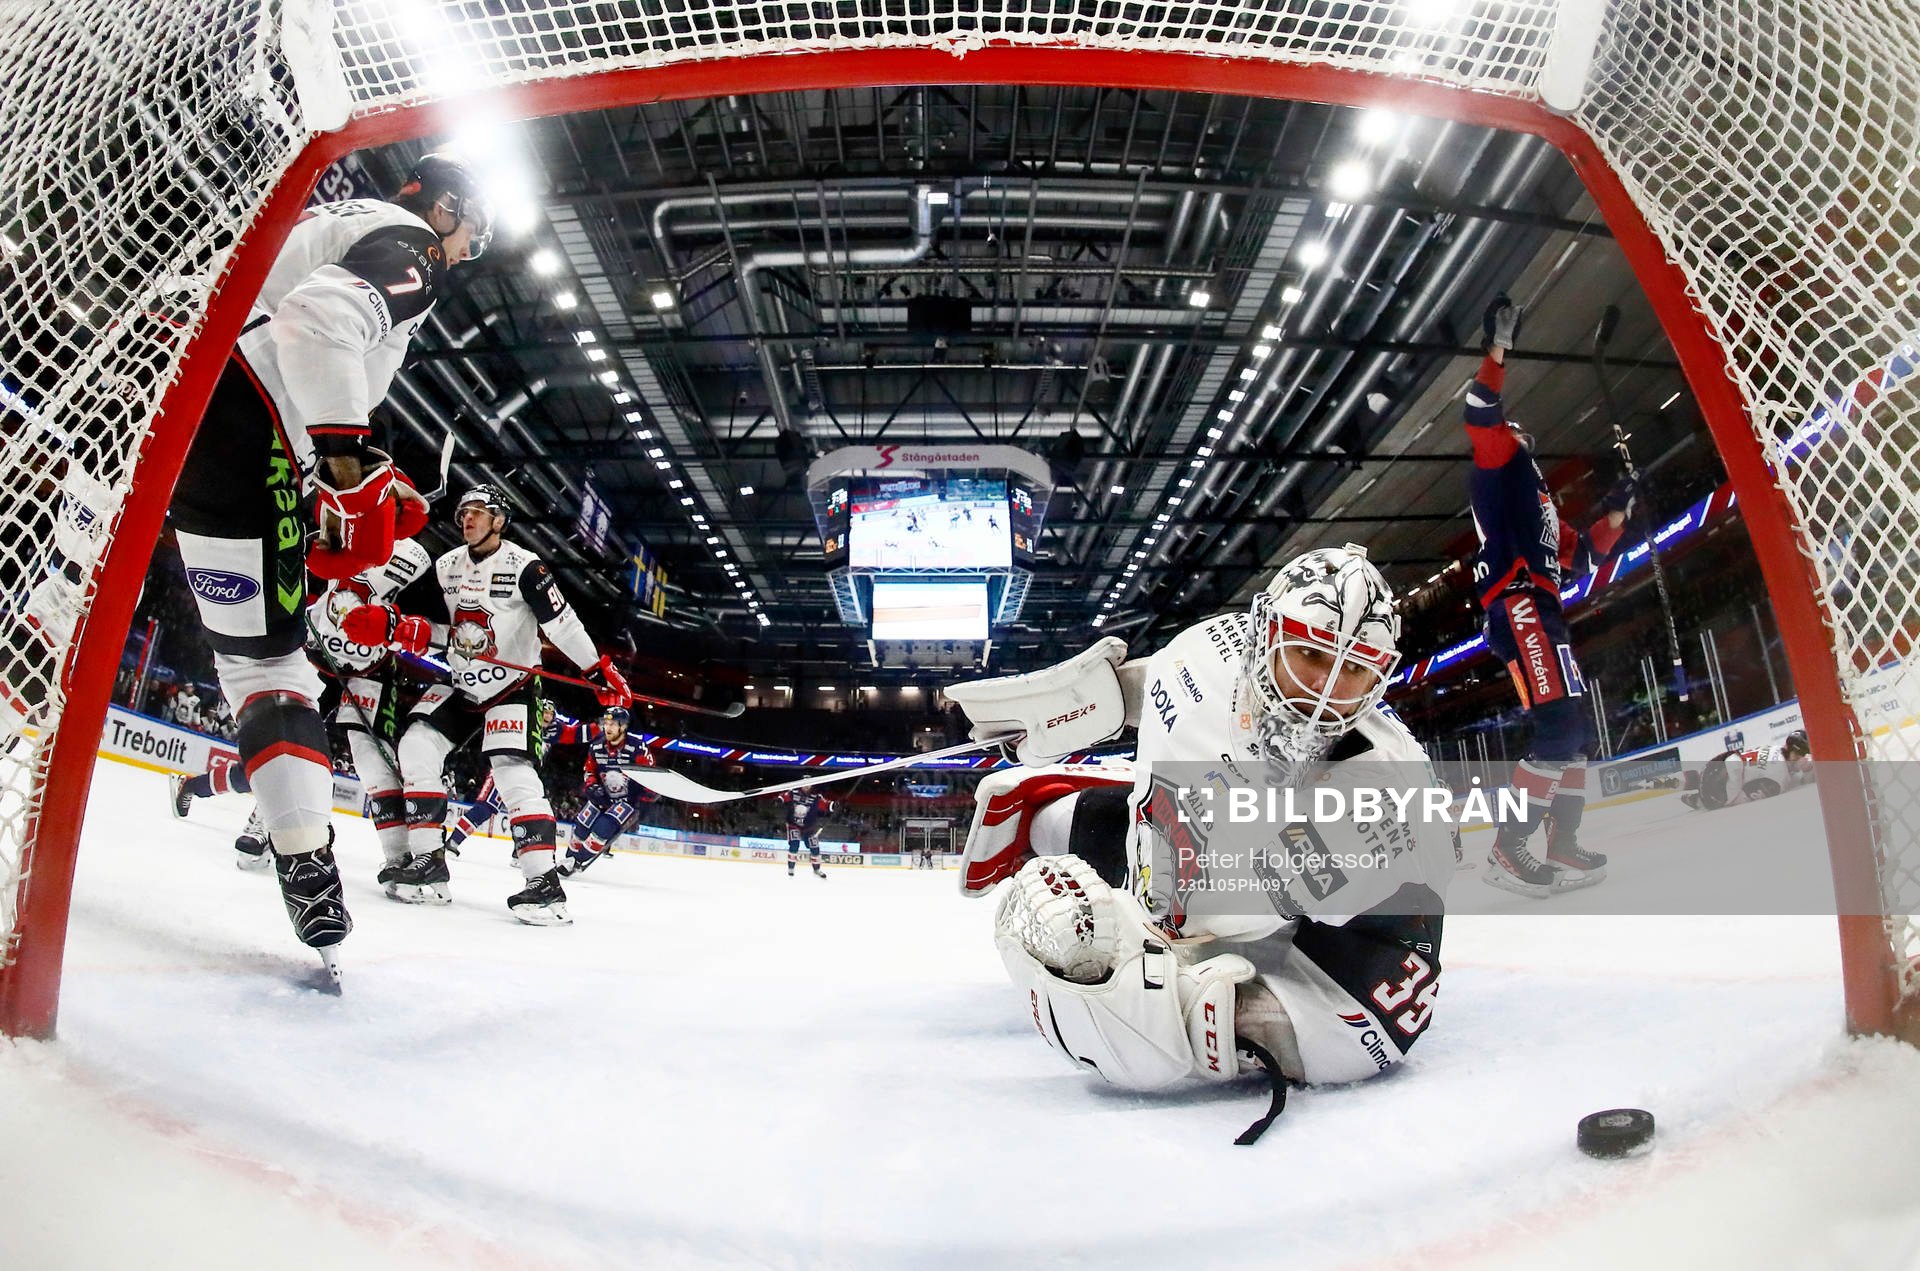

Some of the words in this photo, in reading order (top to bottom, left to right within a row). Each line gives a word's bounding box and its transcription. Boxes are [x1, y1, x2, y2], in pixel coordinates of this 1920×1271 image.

[385, 266, 423, 295] 7
[368, 292, 389, 343] Clima
[901, 452, 980, 464] Stångåstaden
[194, 572, 241, 599] Ford
[1511, 597, 1537, 631] W.
[1205, 625, 1233, 663] HOTEL
[1219, 618, 1244, 657] ARENA
[1150, 679, 1178, 733] DOXA
[112, 719, 187, 764] Trebolit
[486, 719, 524, 734] MAXI
[1372, 951, 1440, 1035] 35
[1204, 1001, 1222, 1073] CCM
